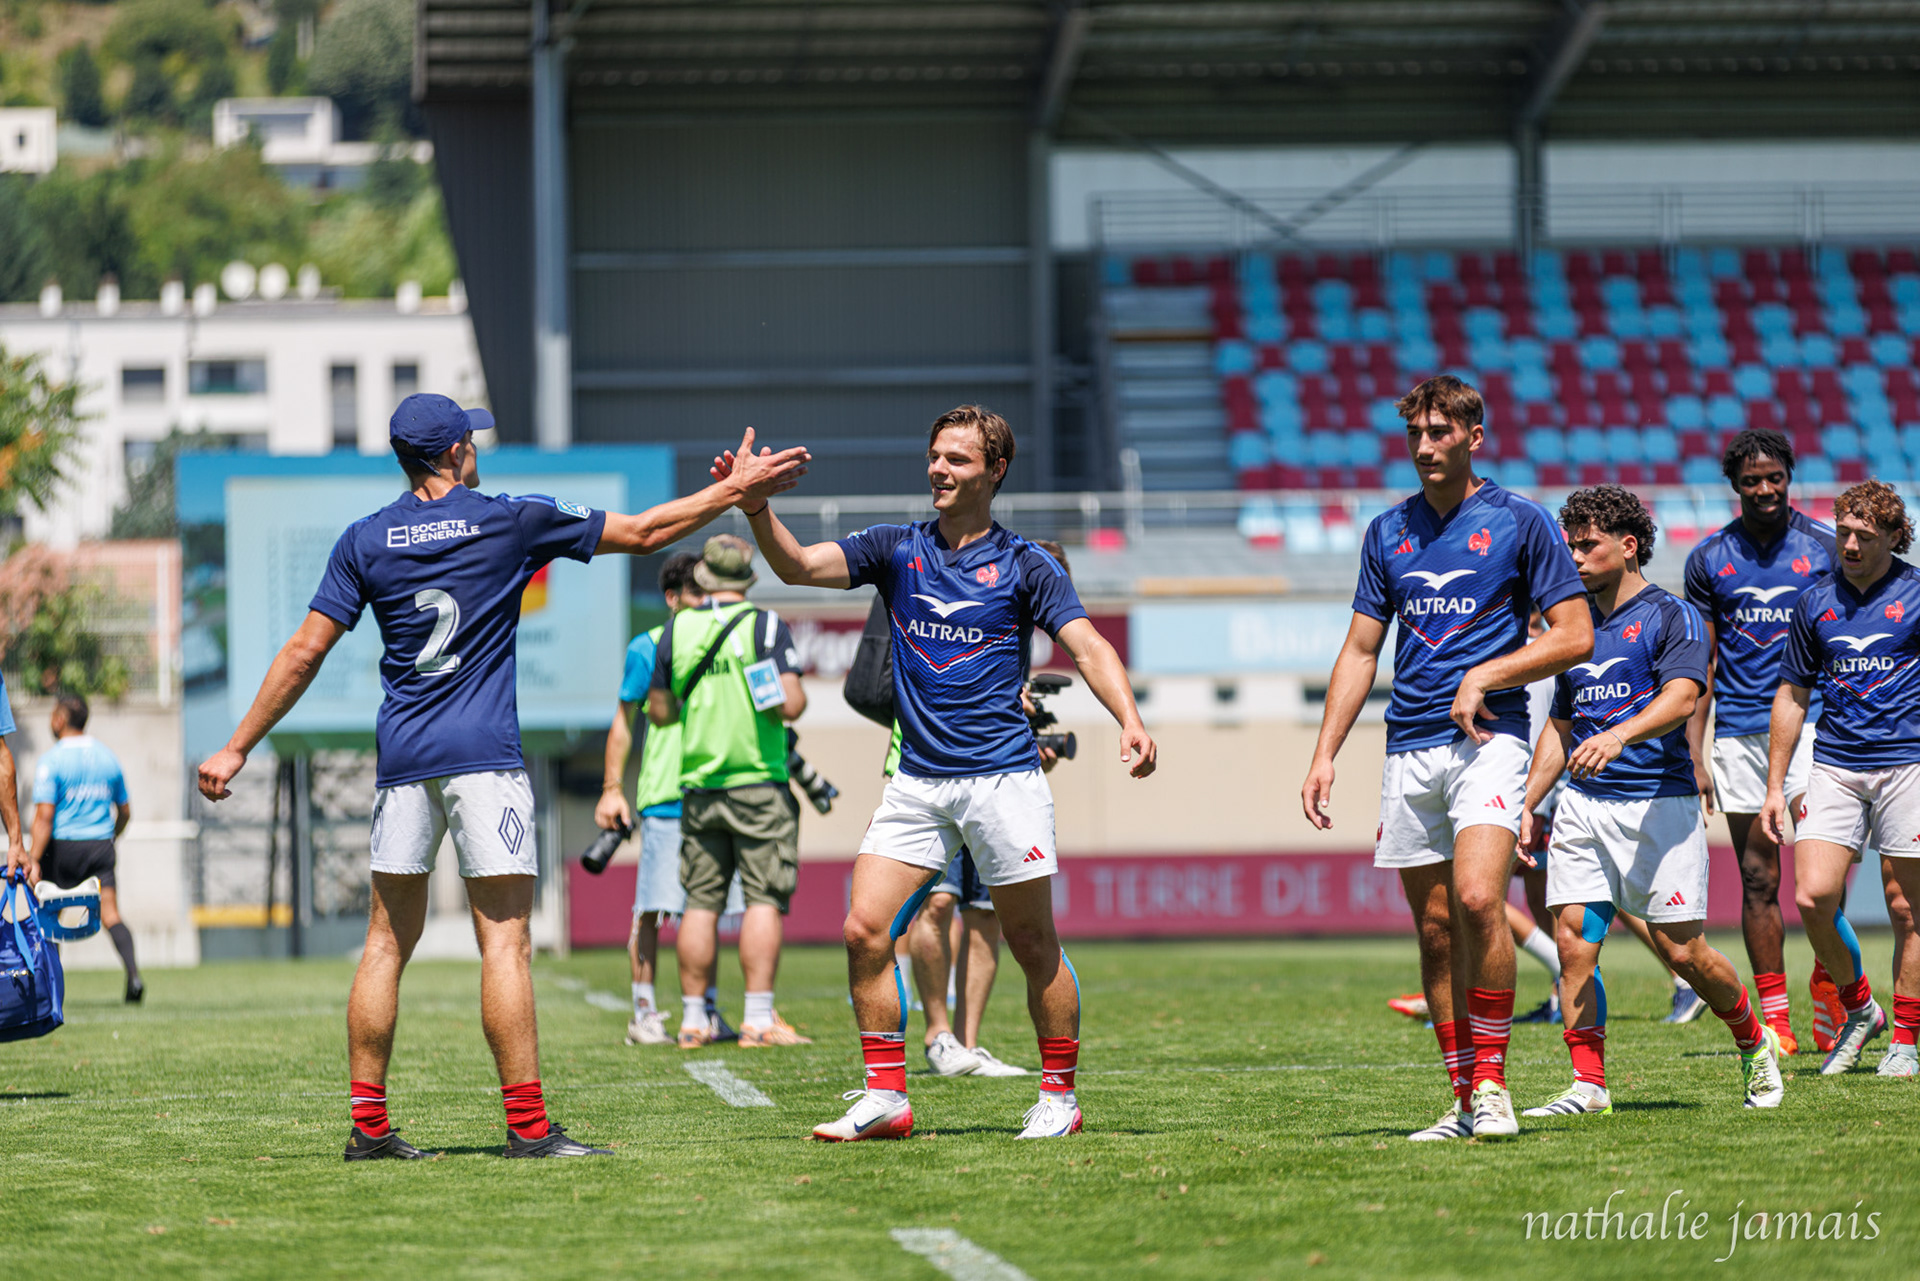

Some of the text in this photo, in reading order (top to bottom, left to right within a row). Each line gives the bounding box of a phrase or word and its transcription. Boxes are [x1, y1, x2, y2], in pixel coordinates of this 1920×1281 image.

[410, 519, 467, 534] SOCIETE
[411, 525, 481, 544] GENERALE
[1403, 597, 1476, 616] ALTRAD
[415, 588, 461, 677] 2
[906, 619, 984, 643] ALTRAD
[1833, 656, 1895, 672] ALTRAD
[1573, 682, 1632, 704] ALTRAD
[1088, 862, 1242, 918] TERRE
[1260, 862, 1331, 917] DE
